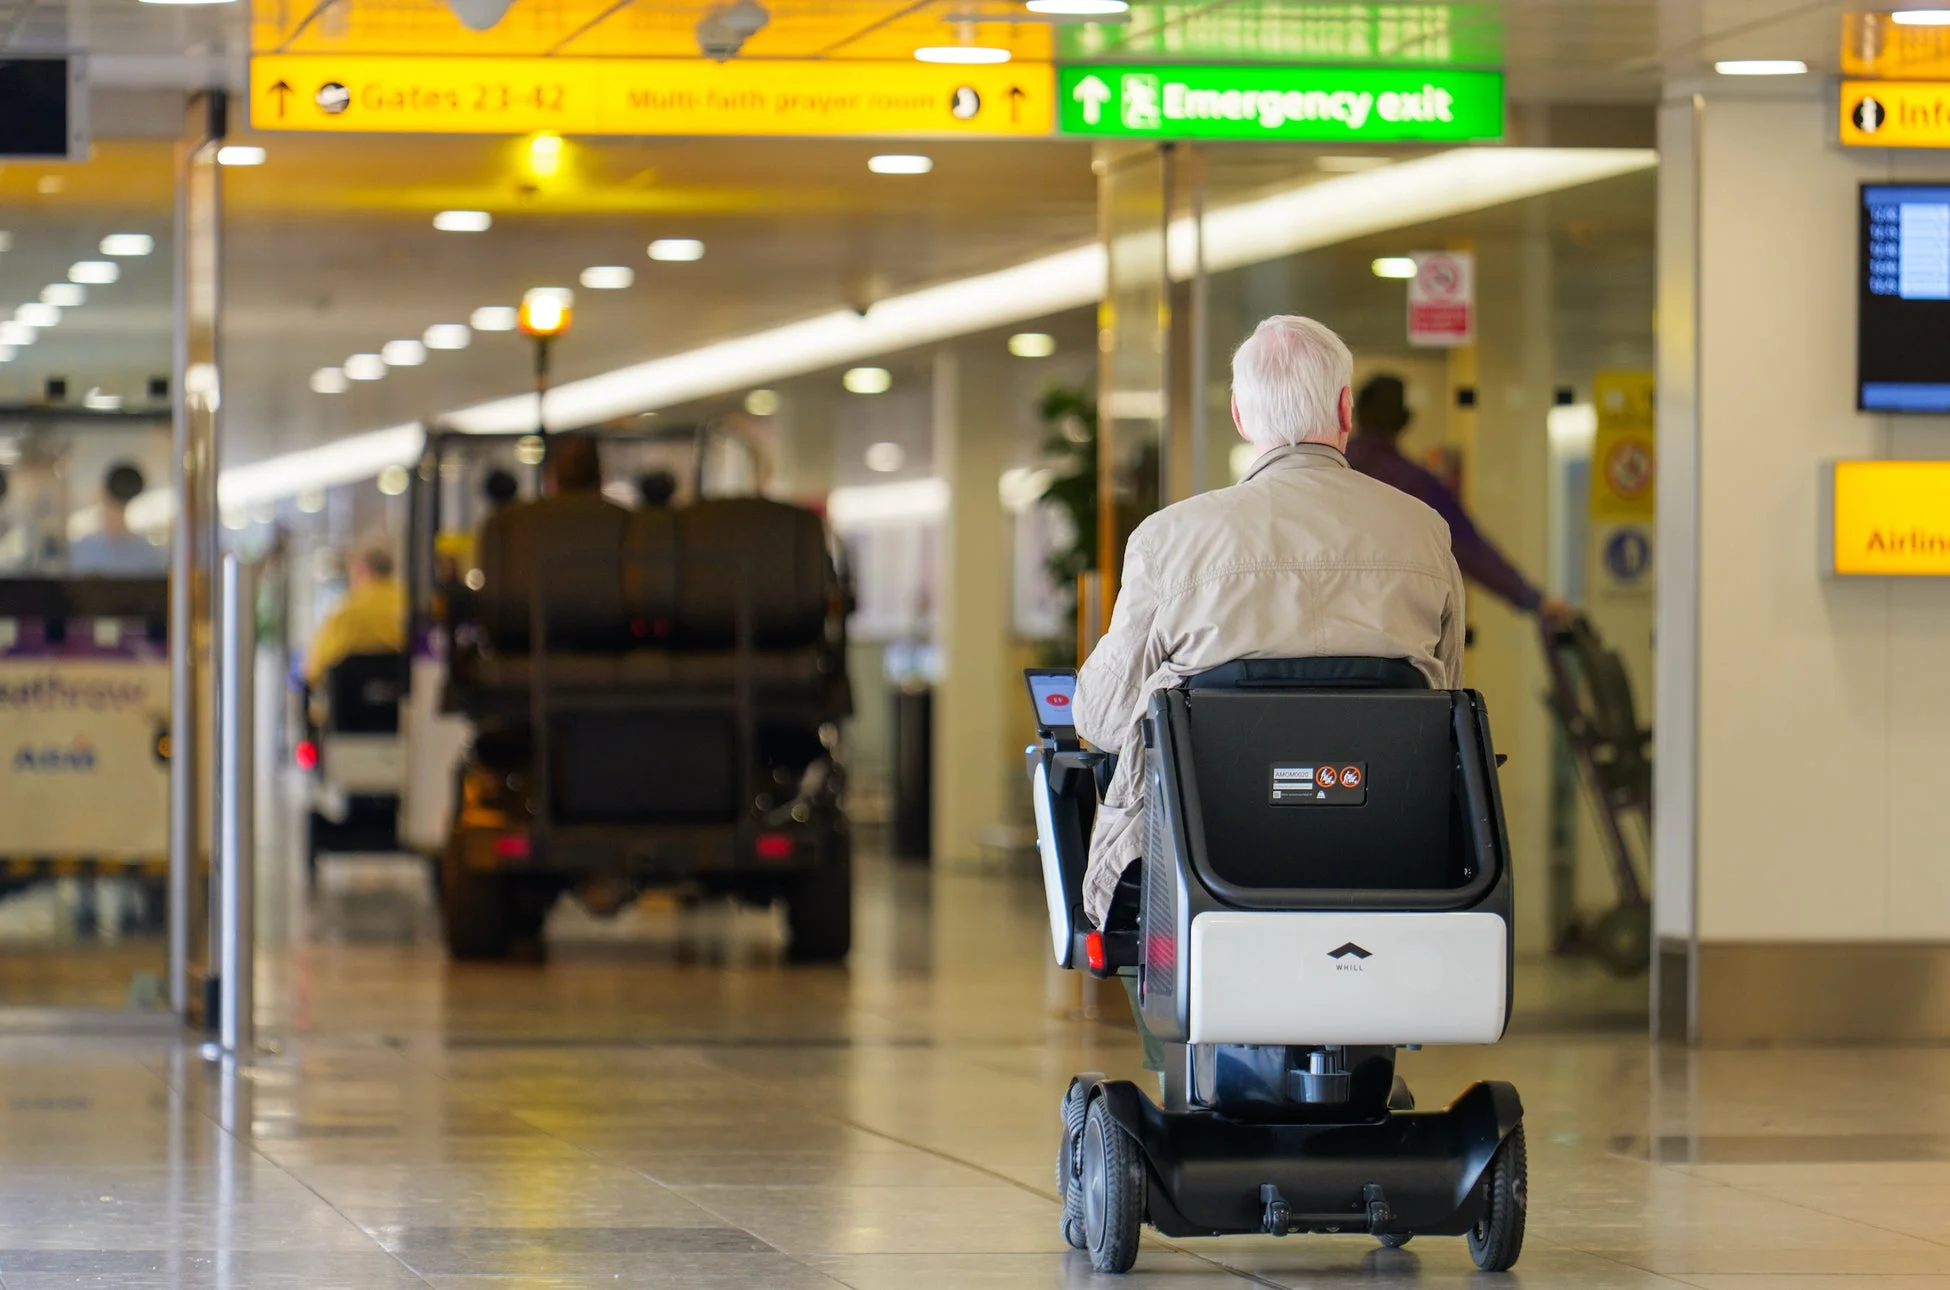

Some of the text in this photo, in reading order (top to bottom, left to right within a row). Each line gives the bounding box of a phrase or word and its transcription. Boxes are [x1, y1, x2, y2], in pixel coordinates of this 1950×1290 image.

[361, 82, 566, 114] Gates 23-42
[627, 88, 934, 118] Multi-faith prayer room
[1162, 83, 1453, 129] Emergency exit
[1865, 524, 1950, 549] Airlin
